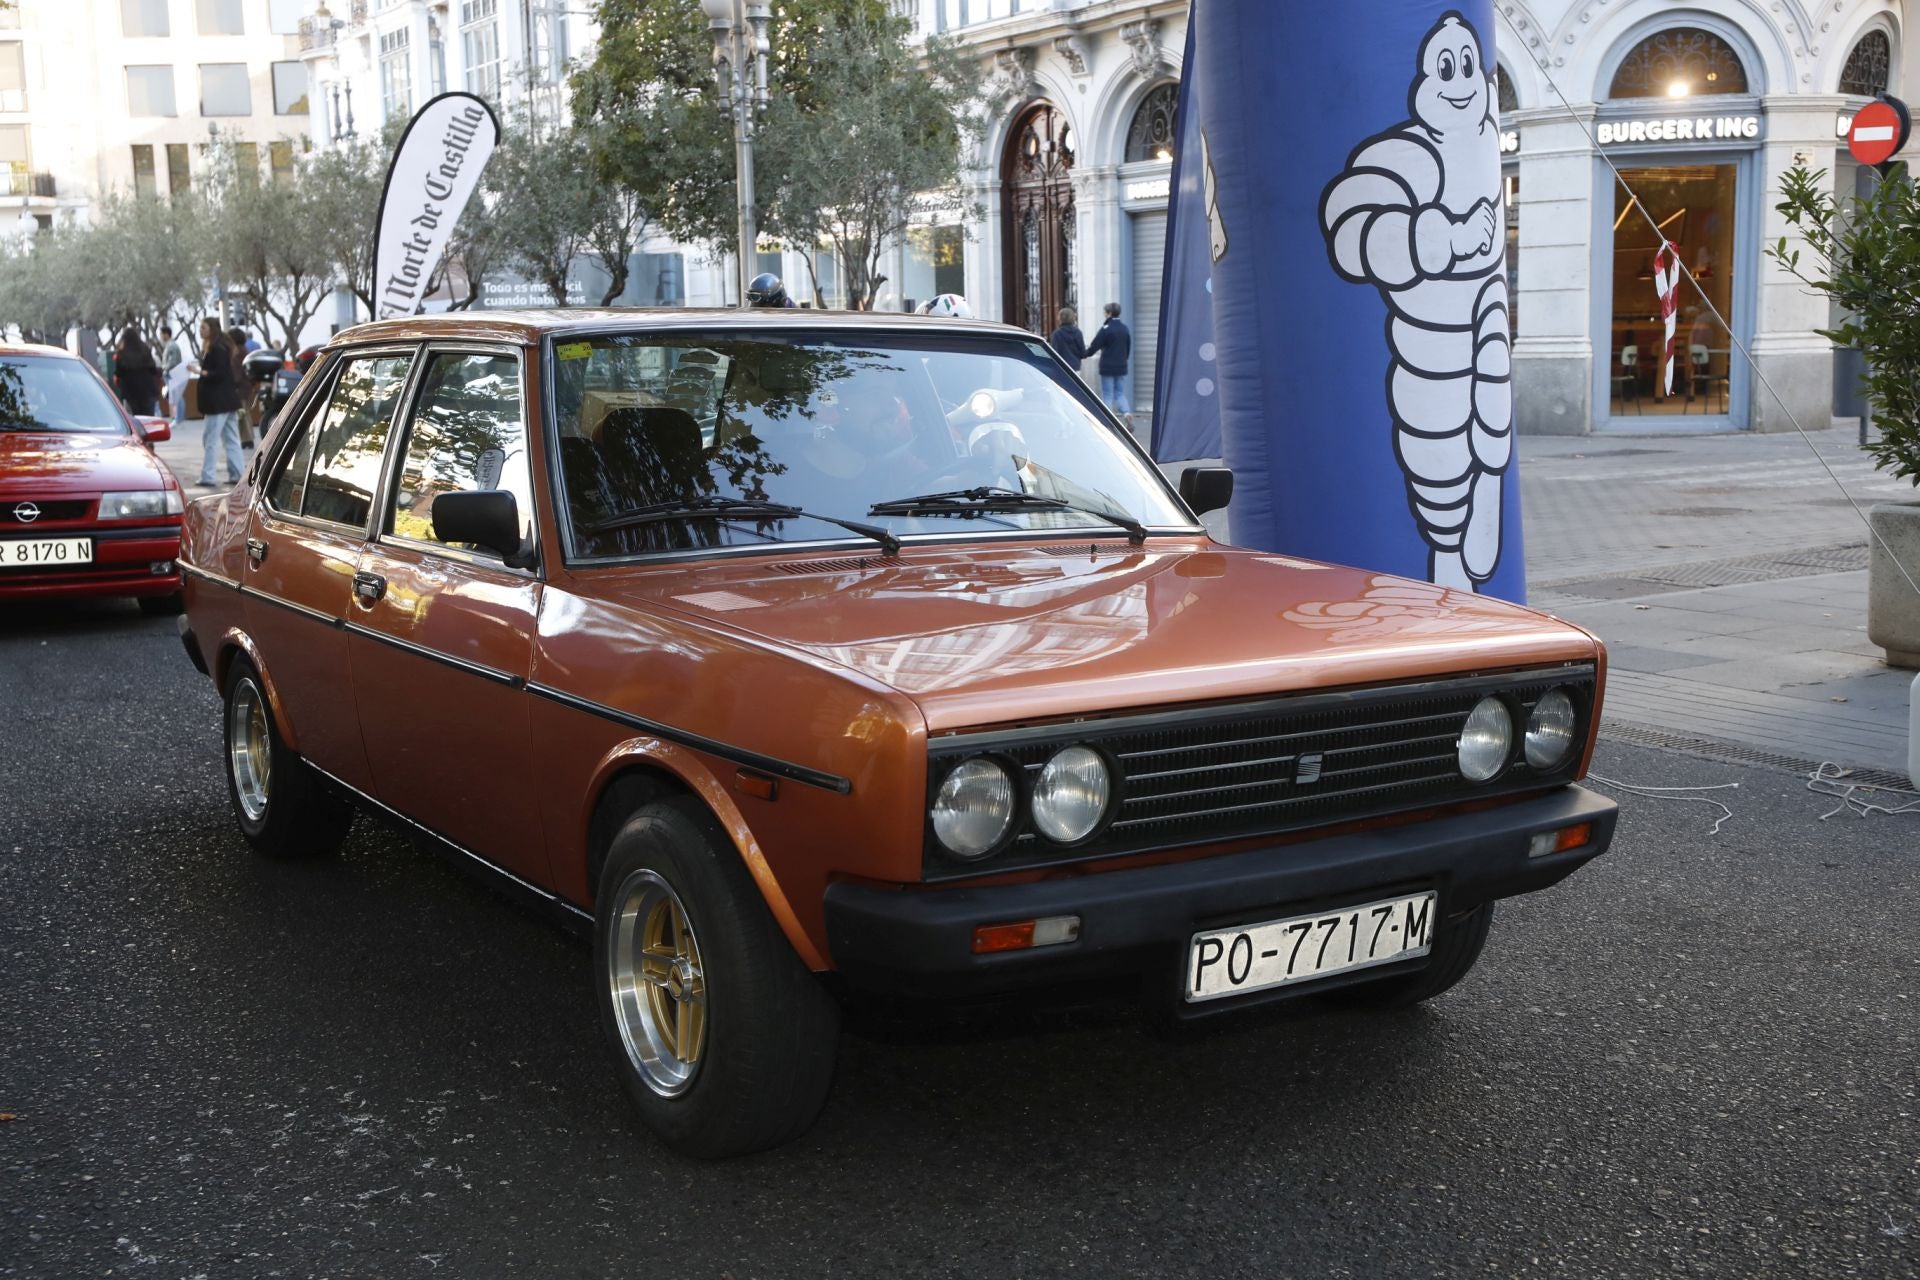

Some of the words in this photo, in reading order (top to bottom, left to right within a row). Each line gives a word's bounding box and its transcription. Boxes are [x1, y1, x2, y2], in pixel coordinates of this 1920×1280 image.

[1598, 118, 1692, 144] BURGER
[1695, 116, 1759, 138] KING
[424, 106, 485, 201] Castilla
[410, 203, 443, 230] de
[385, 231, 432, 299] Norte
[483, 281, 512, 293] Todo
[514, 284, 527, 293] es
[484, 294, 527, 306] cuando
[17, 542, 67, 562] 8170
[77, 541, 90, 560] N
[1195, 899, 1429, 992] PO-7717-M
